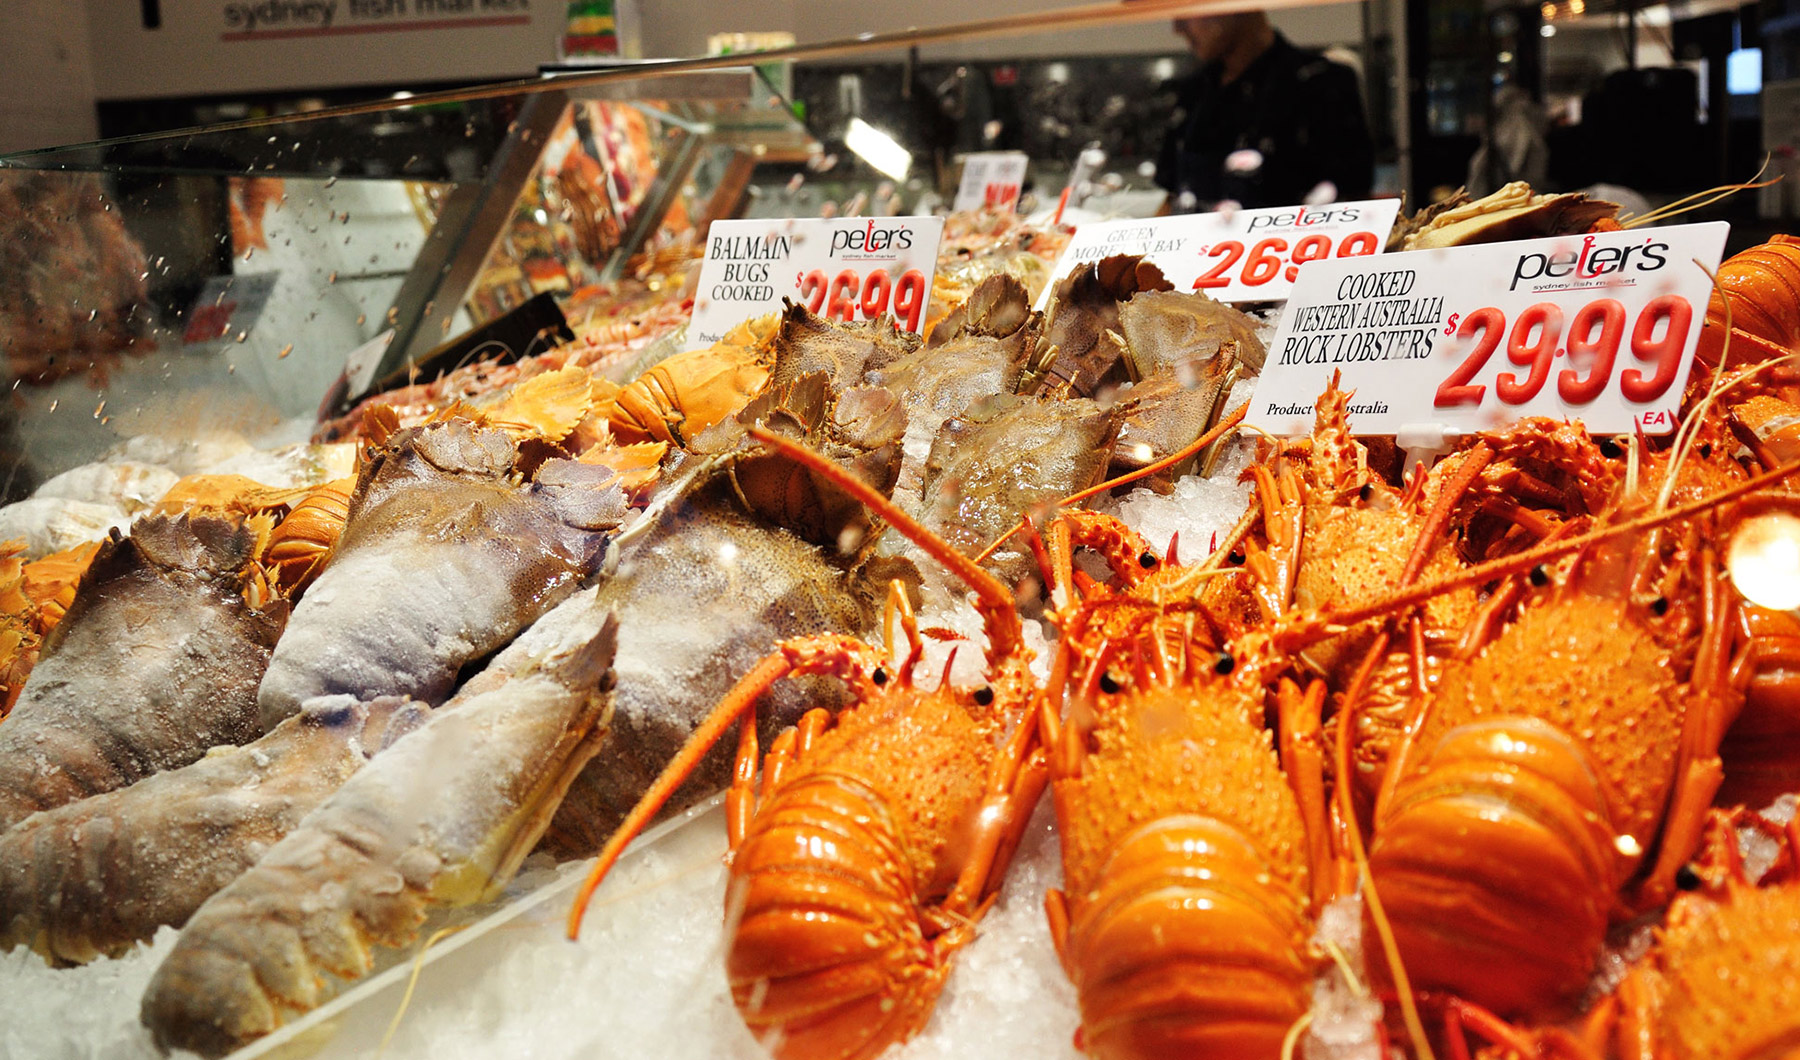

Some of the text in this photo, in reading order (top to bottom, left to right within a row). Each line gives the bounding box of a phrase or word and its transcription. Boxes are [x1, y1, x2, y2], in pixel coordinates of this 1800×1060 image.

[1247, 206, 1361, 234] peter's
[710, 234, 793, 260] BALMAIN
[829, 219, 914, 258] peter's
[1152, 237, 1188, 253] BAY
[723, 263, 770, 283] BUGS
[1509, 235, 1670, 292] peter's
[711, 285, 774, 302] COOKED
[1337, 269, 1416, 301] COOKED
[1532, 282, 1571, 291] sydney
[1292, 296, 1445, 334] WESTERN AUSTRALIA
[1278, 328, 1438, 365] ROCK LOBSTERS
[1266, 400, 1389, 416] Product ustralia
[1642, 411, 1665, 425] EA
